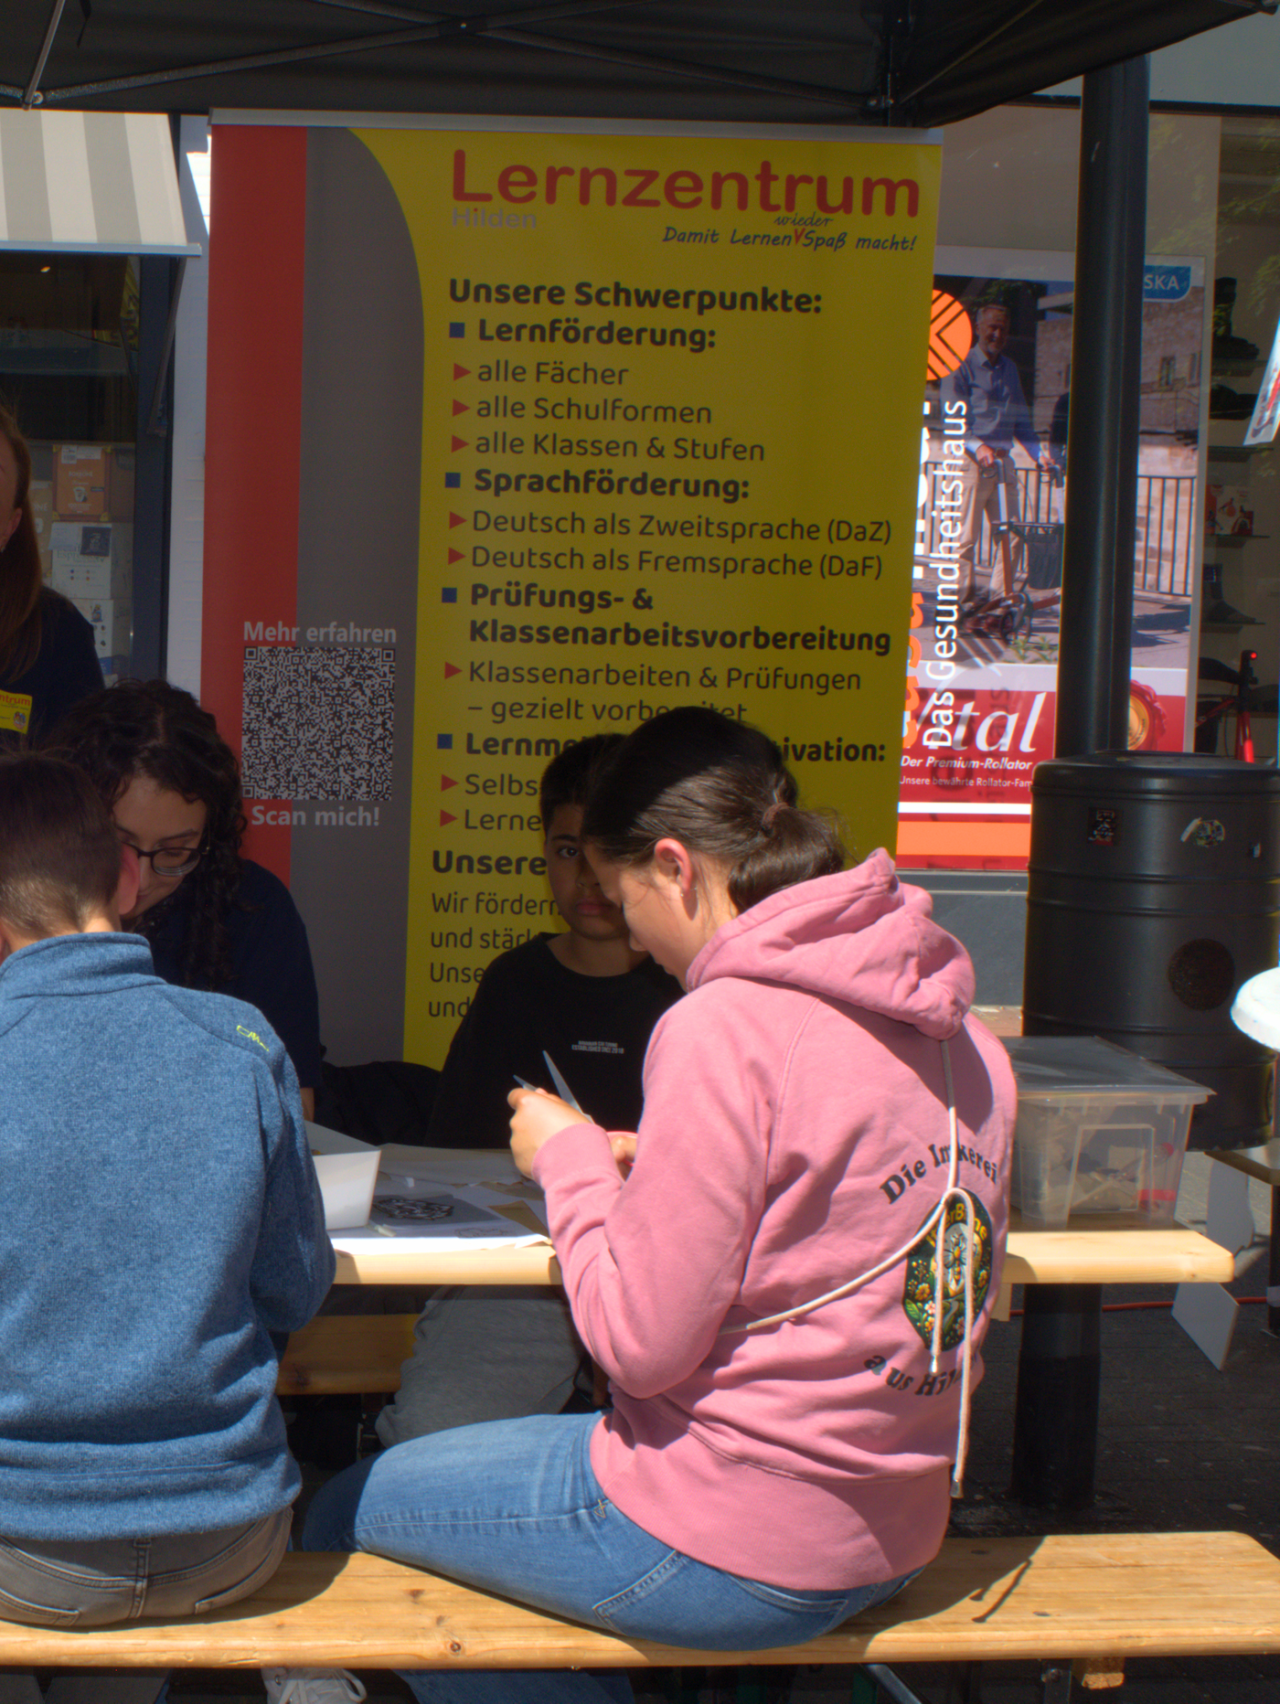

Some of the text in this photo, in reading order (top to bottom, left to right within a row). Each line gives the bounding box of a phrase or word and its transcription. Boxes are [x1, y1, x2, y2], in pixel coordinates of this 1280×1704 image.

[452, 149, 920, 218] Lernzentrum
[451, 207, 538, 230] Hilden
[773, 211, 834, 228] wieder
[662, 226, 918, 253] Damit Lernen Spaß macht!
[1143, 274, 1180, 290] SKA
[449, 278, 822, 315] Unsere Schwerpunkte:
[478, 318, 716, 353] Lernförderung:
[477, 358, 629, 385] alle Fächer
[476, 395, 712, 424] alle Schulformen
[475, 431, 765, 461] alle Klassen & Stufen
[474, 468, 750, 503] Sprachförderung:
[472, 509, 892, 546] Deutsch als Zweitsprache (DaZ)
[471, 545, 883, 581] Deutsch als Fremsprache (DaF)
[922, 400, 968, 747] Das Gesundheitshaus
[470, 581, 653, 614] Prüfungs- &
[243, 621, 397, 643] Mehr erfahren
[469, 619, 891, 656] Klassenarbeitsvorbereitung
[468, 660, 861, 696] Klassenarbeiten & Prüfungen
[491, 697, 583, 724] gezielt
[900, 755, 1033, 771] Der Premium-Rollator
[465, 774, 538, 796] Selbs
[251, 805, 380, 827] Scan mich!
[465, 809, 542, 831] Lerne
[432, 850, 547, 876] Unsere
[432, 891, 469, 914] Wir
[431, 927, 472, 949] und
[430, 962, 485, 983] Unse
[879, 1160, 926, 1205] Die
